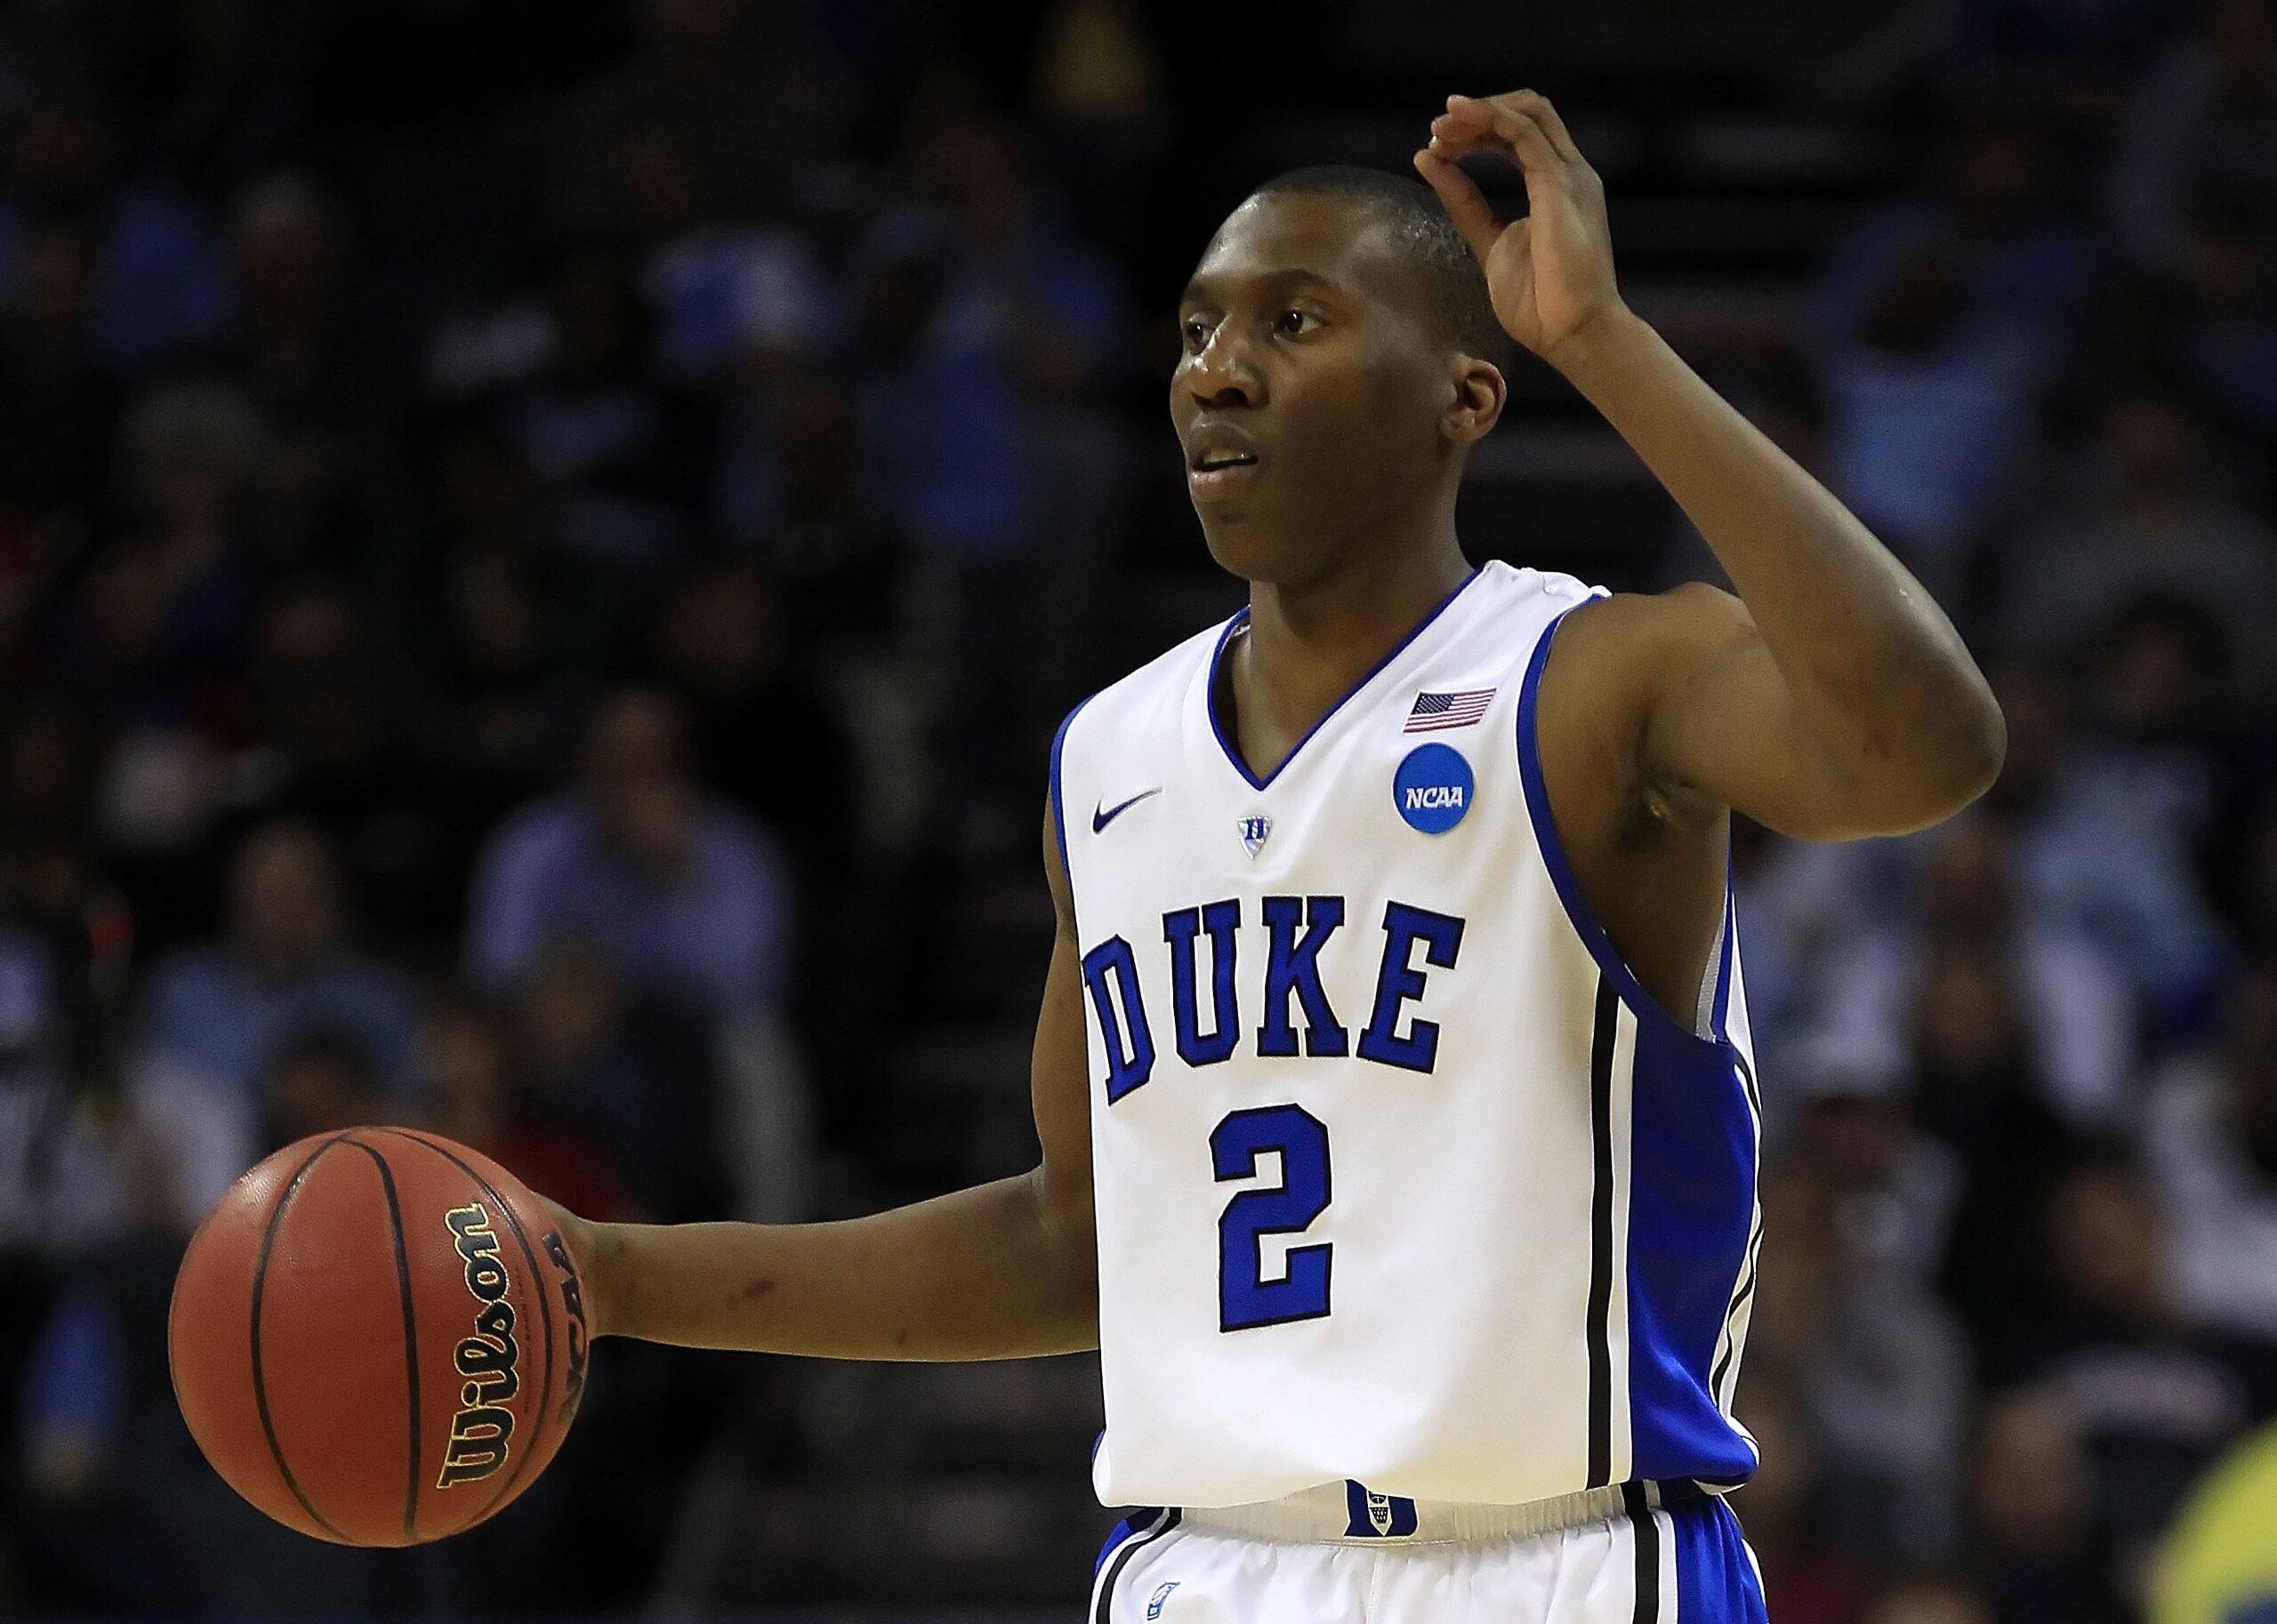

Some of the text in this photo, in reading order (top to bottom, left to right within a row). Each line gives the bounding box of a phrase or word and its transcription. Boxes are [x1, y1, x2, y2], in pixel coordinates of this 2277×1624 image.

[1405, 786, 1463, 809] NCAA
[1082, 896, 1466, 1106] DUKE
[1209, 1104, 1333, 1332] 2
[437, 1202, 519, 1489] Wilson
